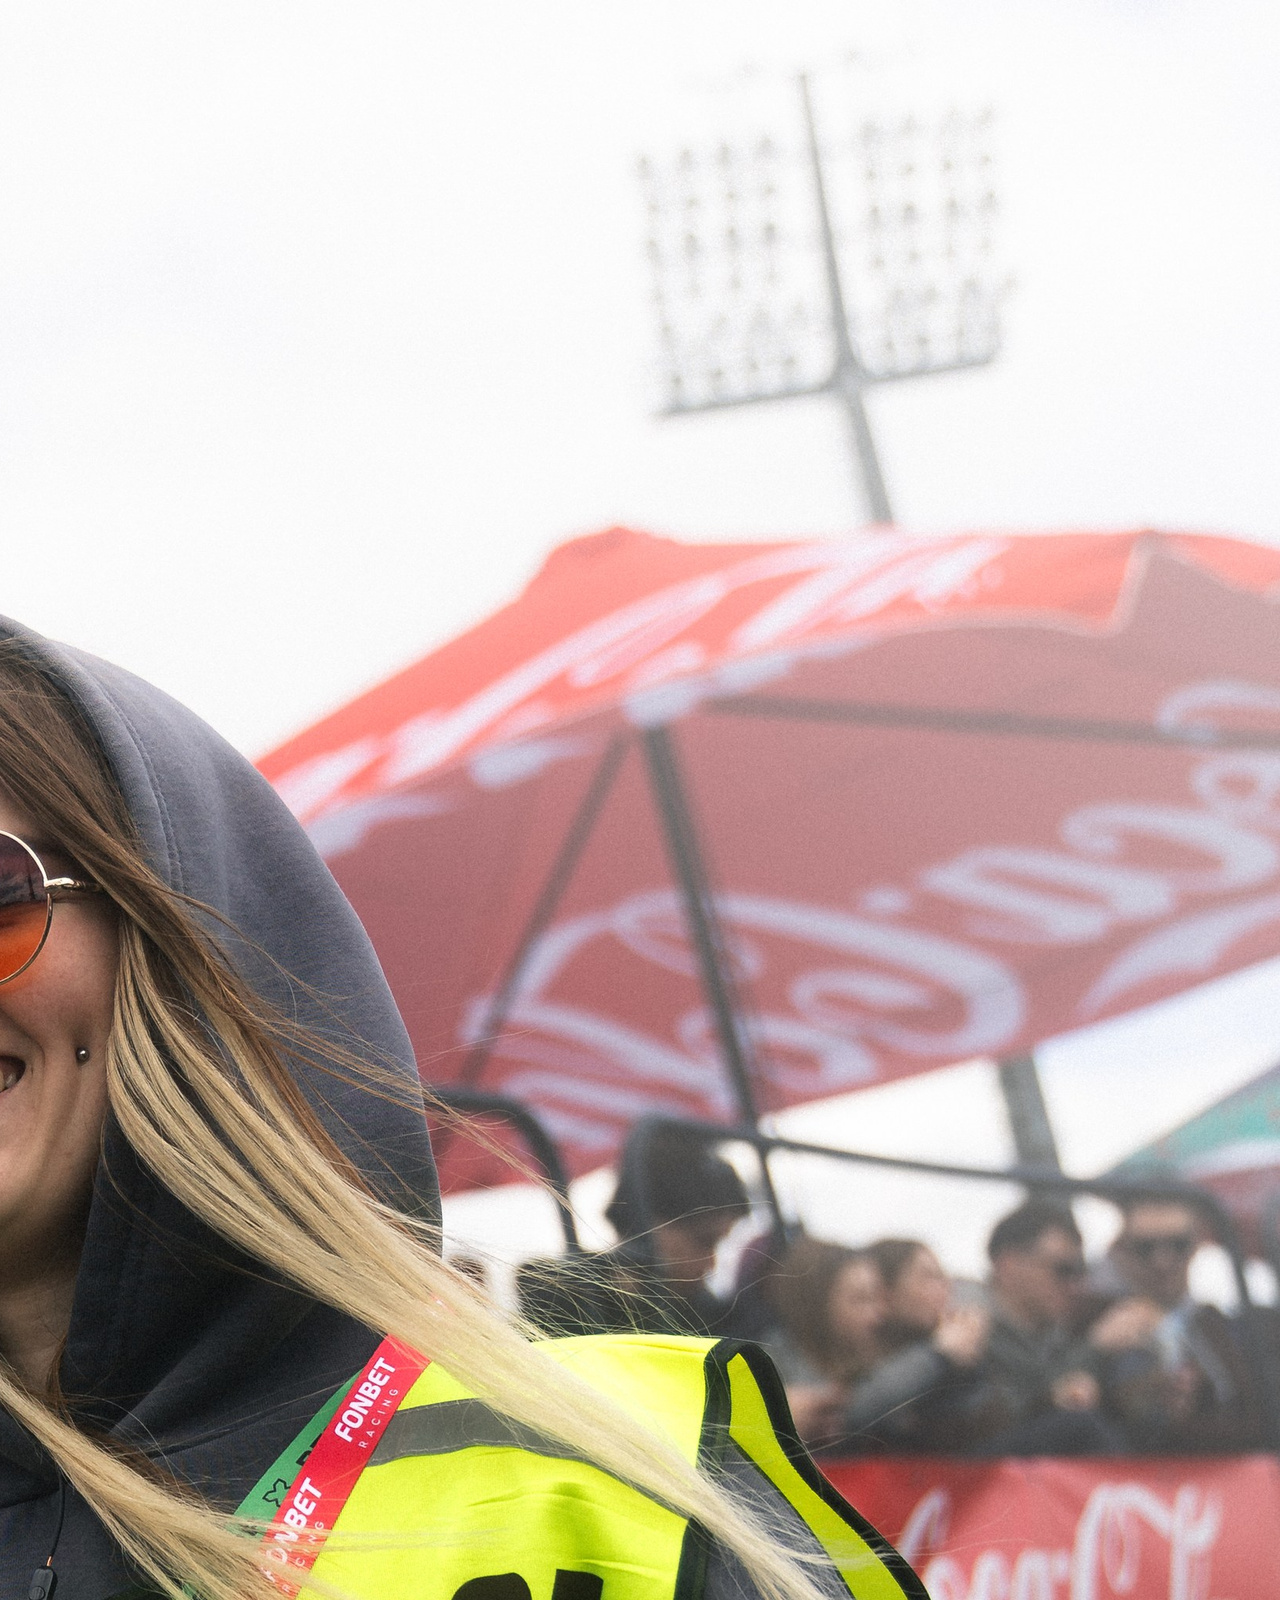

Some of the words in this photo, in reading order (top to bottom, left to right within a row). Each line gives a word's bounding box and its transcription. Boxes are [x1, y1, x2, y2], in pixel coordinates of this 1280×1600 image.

[334, 1356, 397, 1443] FONBET
[358, 1388, 399, 1449] RACING
[281, 1520, 325, 1593] RCING
